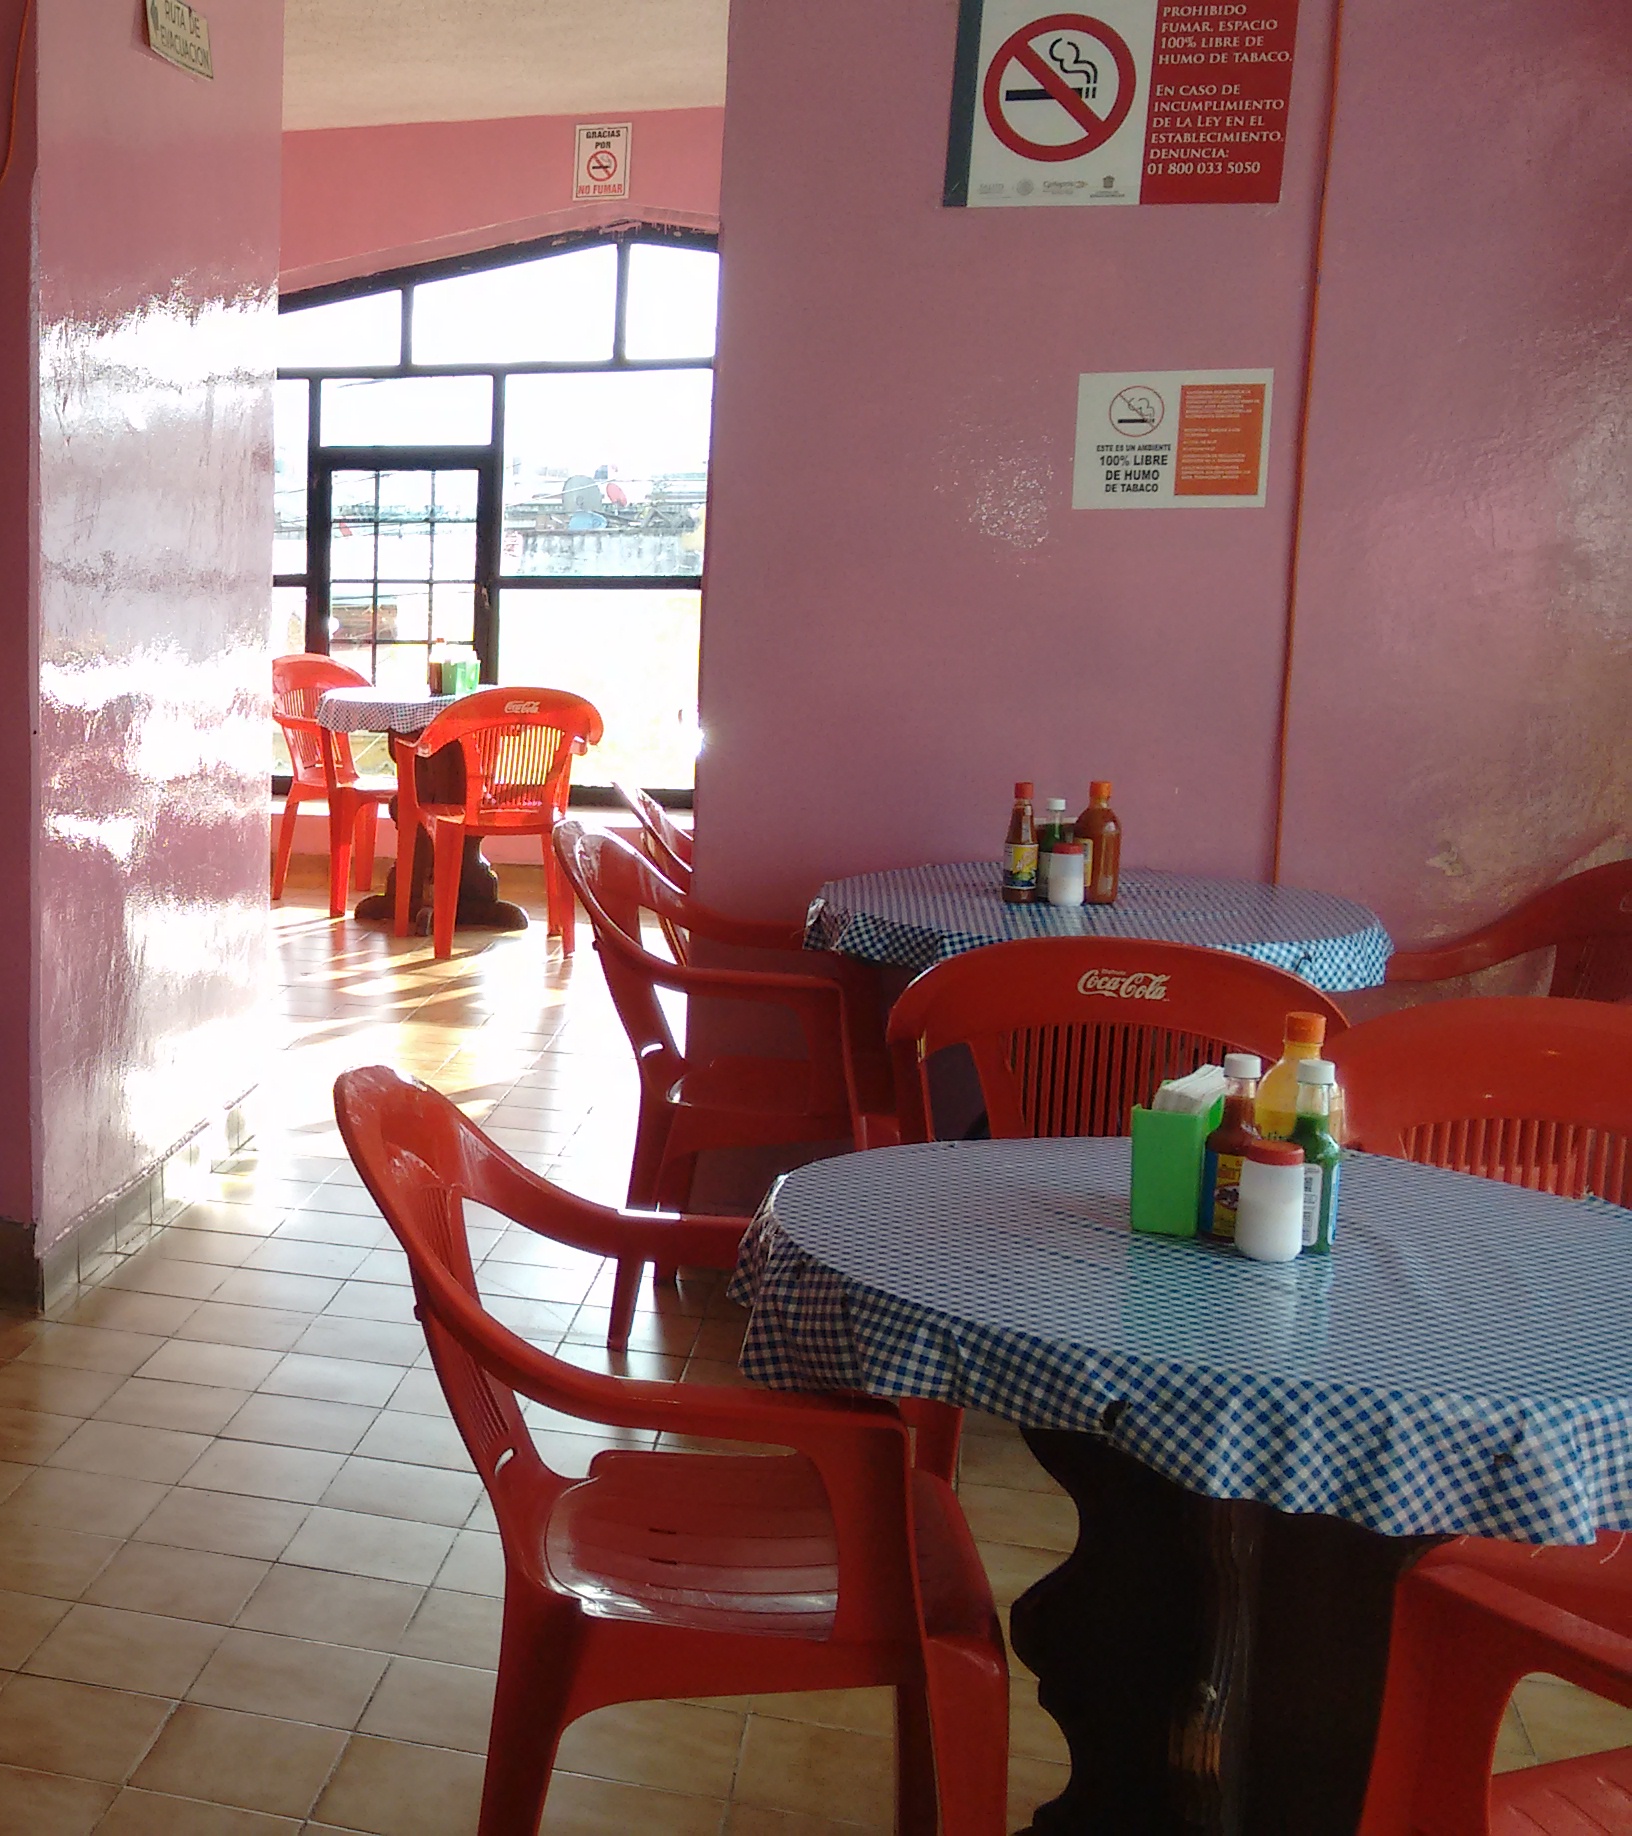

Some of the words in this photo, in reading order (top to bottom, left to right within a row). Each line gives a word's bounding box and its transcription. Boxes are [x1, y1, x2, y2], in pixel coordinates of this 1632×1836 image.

[1162, 4, 1247, 17] PROHIBIDO
[1218, 19, 1278, 32] ESPACIO
[1161, 36, 1197, 49] 100%
[1201, 36, 1240, 48] LIBRE
[1245, 36, 1265, 47] DE
[1158, 53, 1205, 65] HUMO
[1209, 53, 1229, 64] DE
[1233, 51, 1293, 63] TABACO.
[1179, 84, 1217, 96] CASO
[1221, 84, 1241, 95] DE
[1154, 99, 1285, 112] INCUMPLIMIENTO
[1152, 117, 1171, 128] DE
[1176, 116, 1193, 127] LA
[1225, 116, 1245, 127] EN
[1249, 115, 1265, 127] EL
[585, 130, 621, 139] GRACIAS
[1151, 131, 1285, 144] ESTABLECIMIENTO.
[594, 141, 611, 149] POR
[1149, 148, 1230, 160] DENUNCIA:
[1147, 163, 1163, 175] 01
[1167, 162, 1194, 175] 800
[1197, 162, 1223, 174] 033
[1226, 161, 1261, 174] 5050
[578, 185, 590, 195] NO
[592, 183, 623, 194] FUMAR
[1096, 444, 1113, 452] ESTE
[1115, 444, 1125, 452] ES
[1125, 444, 1136, 452] UN
[1137, 443, 1171, 452] AMBIENTE
[1099, 455, 1130, 466] 100%
[1133, 454, 1169, 466] LIBRE
[1105, 470, 1121, 481] DE
[1124, 469, 1160, 481] HUMO
[1104, 484, 1119, 493] DE
[1120, 483, 1159, 493] TABACO
